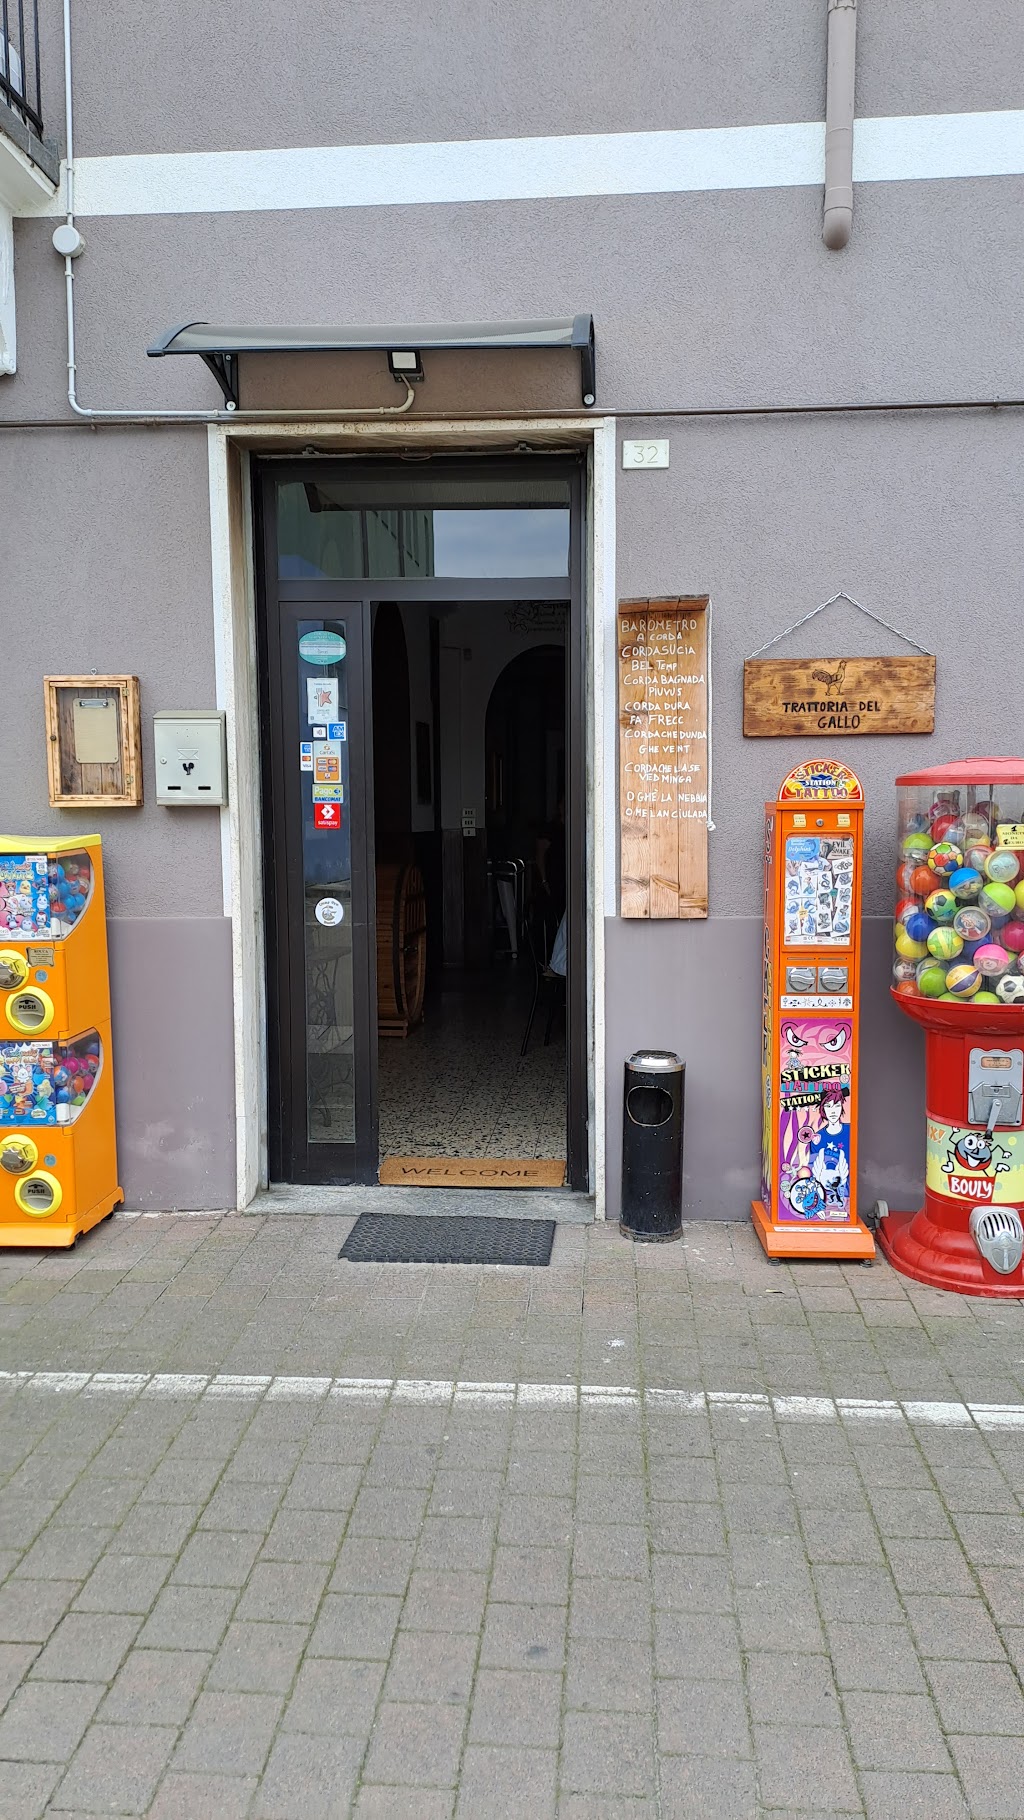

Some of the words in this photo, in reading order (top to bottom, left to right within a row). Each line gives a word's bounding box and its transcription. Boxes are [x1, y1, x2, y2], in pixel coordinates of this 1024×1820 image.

[633, 445, 658, 463] 32
[621, 619, 697, 633] BAROMETRO
[637, 633, 645, 641] A
[650, 632, 682, 641] CORDA
[631, 660, 653, 671] BEL
[623, 674, 658, 685] CORDA
[661, 674, 706, 685] BAGNADA
[624, 701, 661, 712] CORDA
[664, 701, 691, 711] DURA
[782, 701, 849, 713] TRATTORIA
[859, 700, 881, 712] DEL
[630, 715, 642, 725] FA
[648, 714, 684, 726] FRECC
[817, 714, 861, 729] GALLO
[680, 731, 707, 740] DUNDA
[639, 744, 659, 754] GHE
[663, 744, 691, 754] VENT
[796, 763, 848, 780] STICKER
[639, 773, 660, 782] VED
[661, 773, 692, 784] MINGA
[661, 793, 673, 802] LA
[678, 792, 707, 803] NEBBIA
[795, 787, 848, 798] TATTOO
[781, 1064, 851, 1082] STICKER
[785, 1081, 841, 1092] TATTOO
[780, 1093, 822, 1107] STATION
[401, 1167, 540, 1177] WELCOME
[950, 1177, 992, 1199] BOULY
